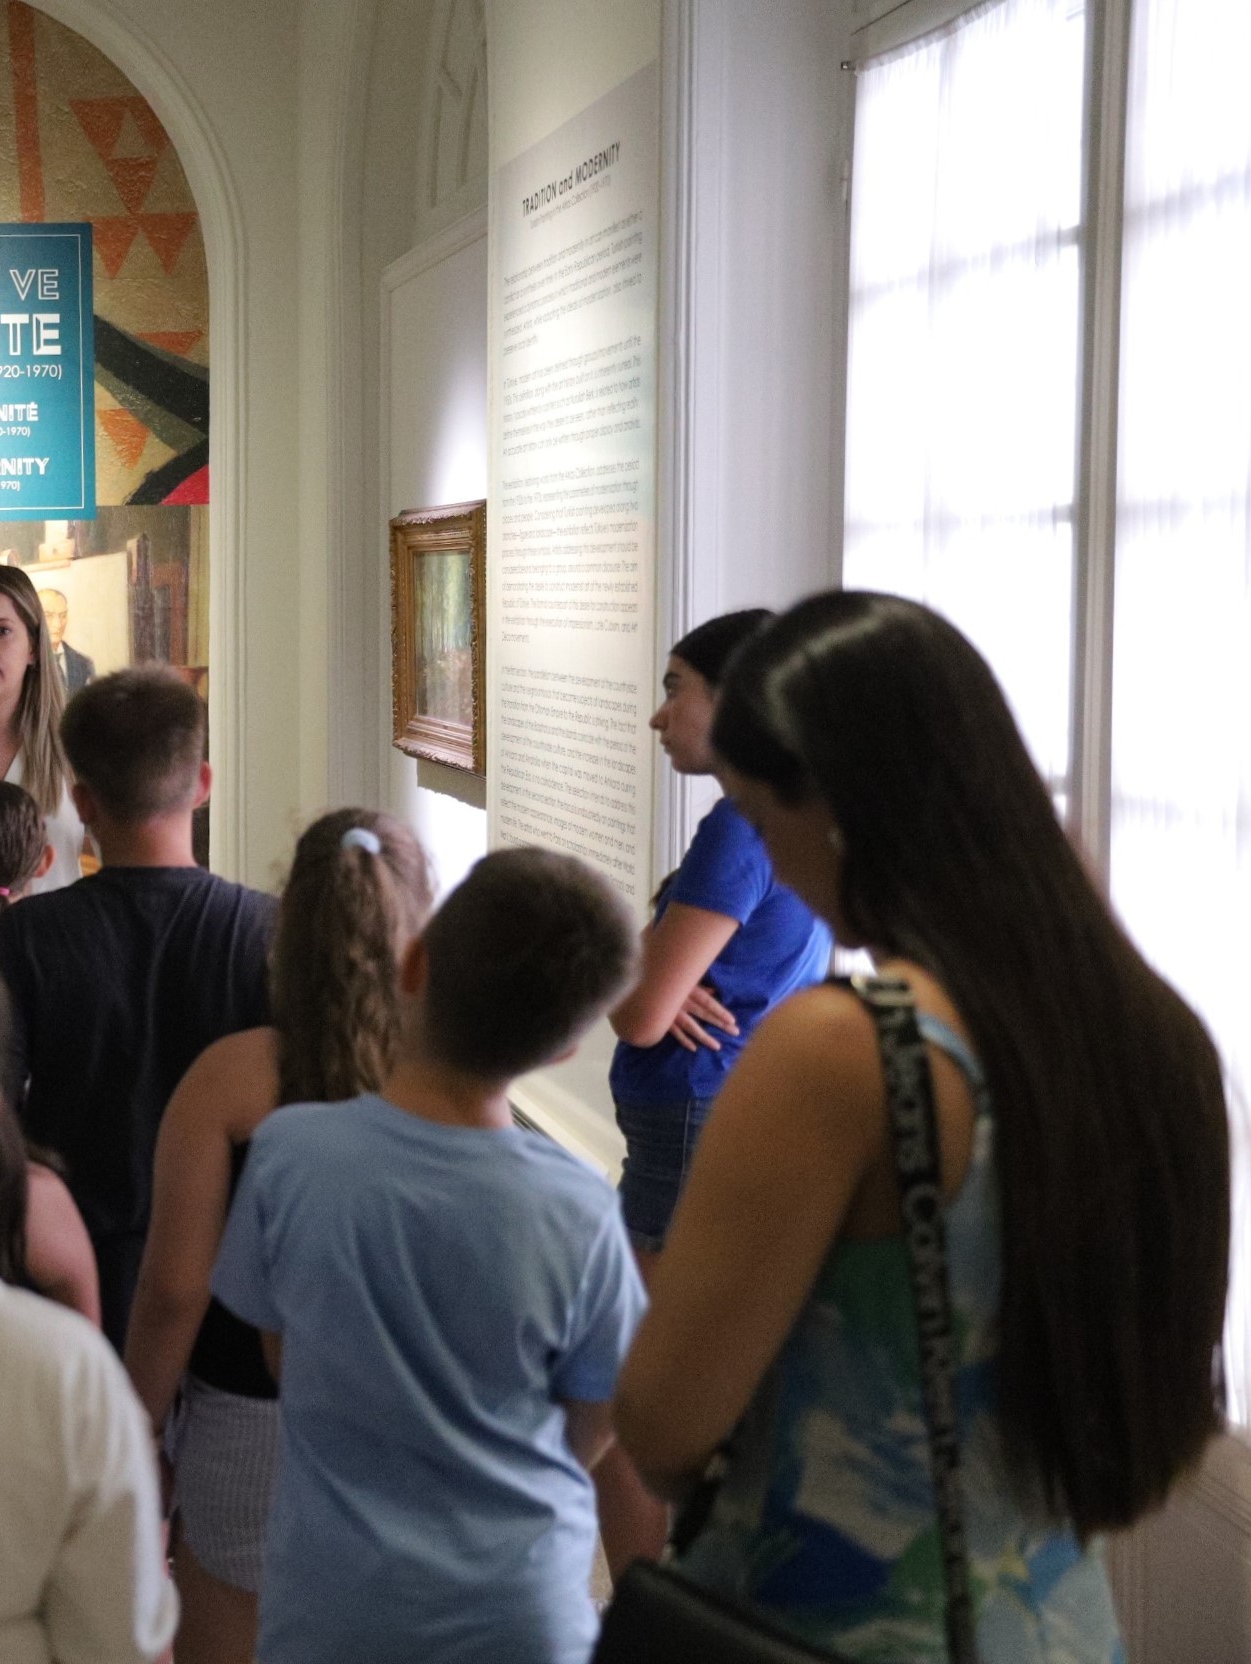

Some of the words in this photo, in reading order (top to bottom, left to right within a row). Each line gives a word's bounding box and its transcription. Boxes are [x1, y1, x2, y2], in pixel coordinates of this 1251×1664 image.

[522, 180, 556, 216] TRADITION
[558, 173, 572, 195] and
[575, 141, 620, 186] MODERNITY
[9, 269, 60, 301] VE
